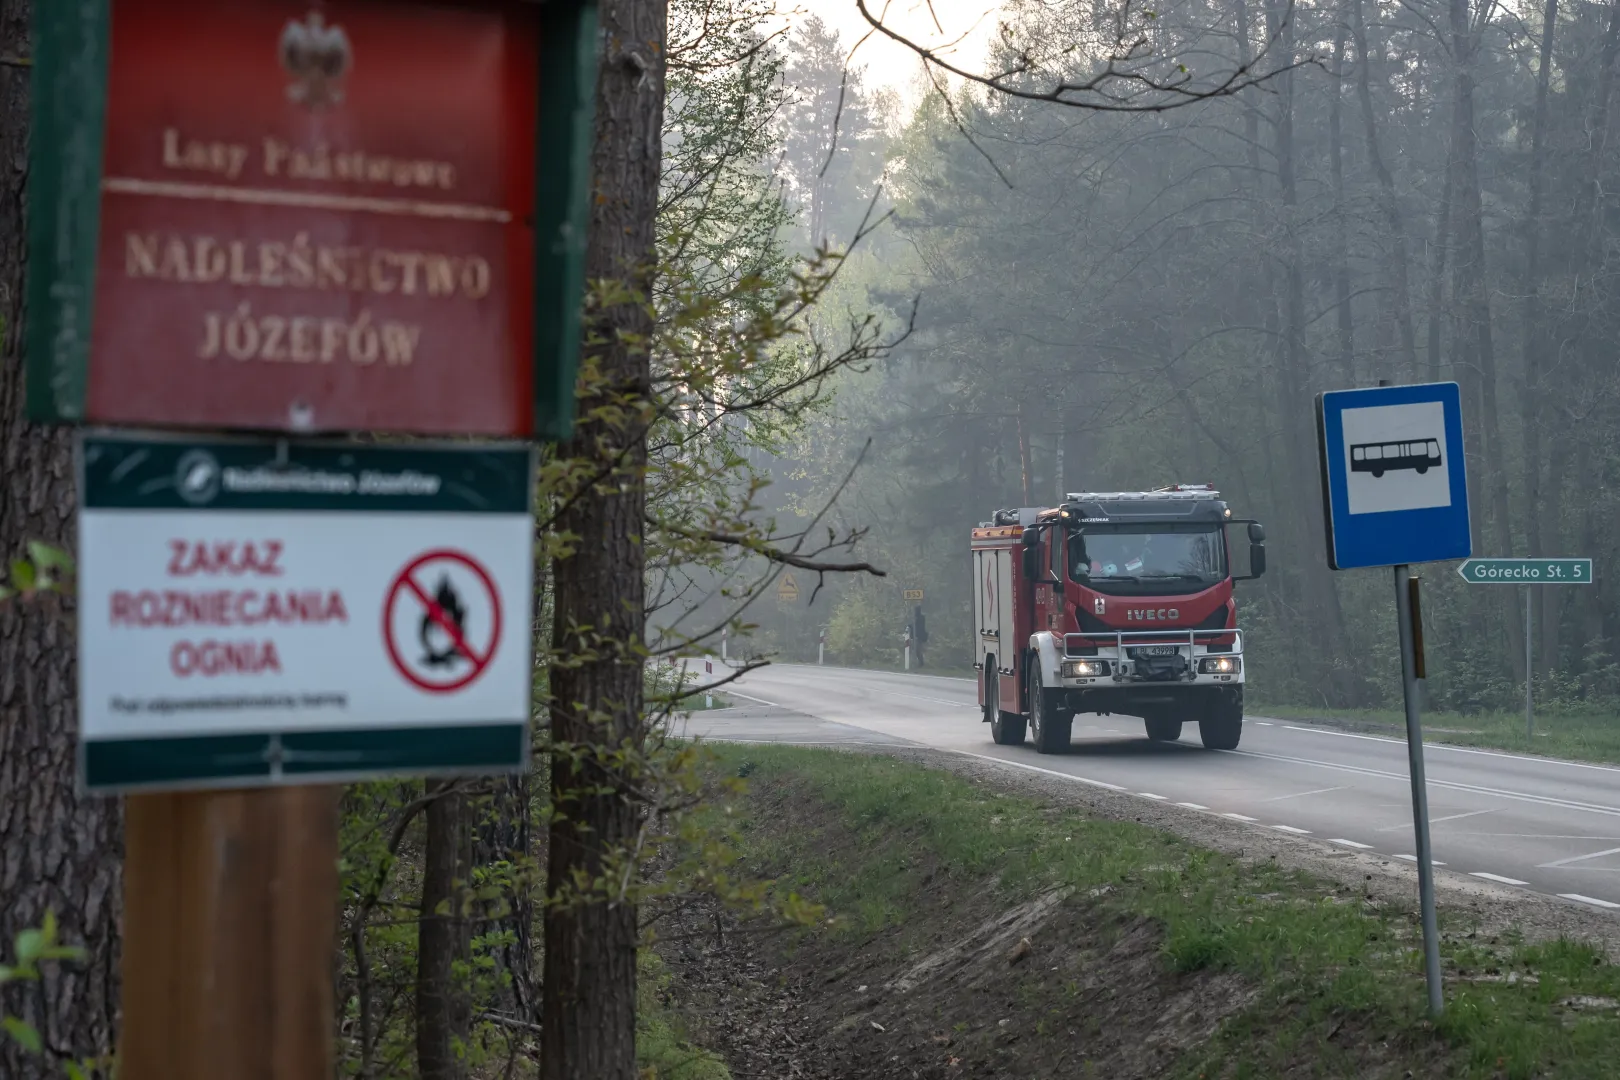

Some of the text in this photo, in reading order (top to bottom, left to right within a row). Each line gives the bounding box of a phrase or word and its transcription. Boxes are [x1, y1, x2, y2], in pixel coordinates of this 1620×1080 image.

[124, 230, 491, 298] NADLEŚNICTWO
[198, 304, 420, 365] JÓZEFÓW
[167, 540, 285, 577] ZAKAZ
[1474, 565, 1582, 578] Górecko St. 5
[109, 590, 348, 630] ROZNIECANIA
[1127, 609, 1179, 621] IVECO
[170, 641, 281, 678] OGNIA
